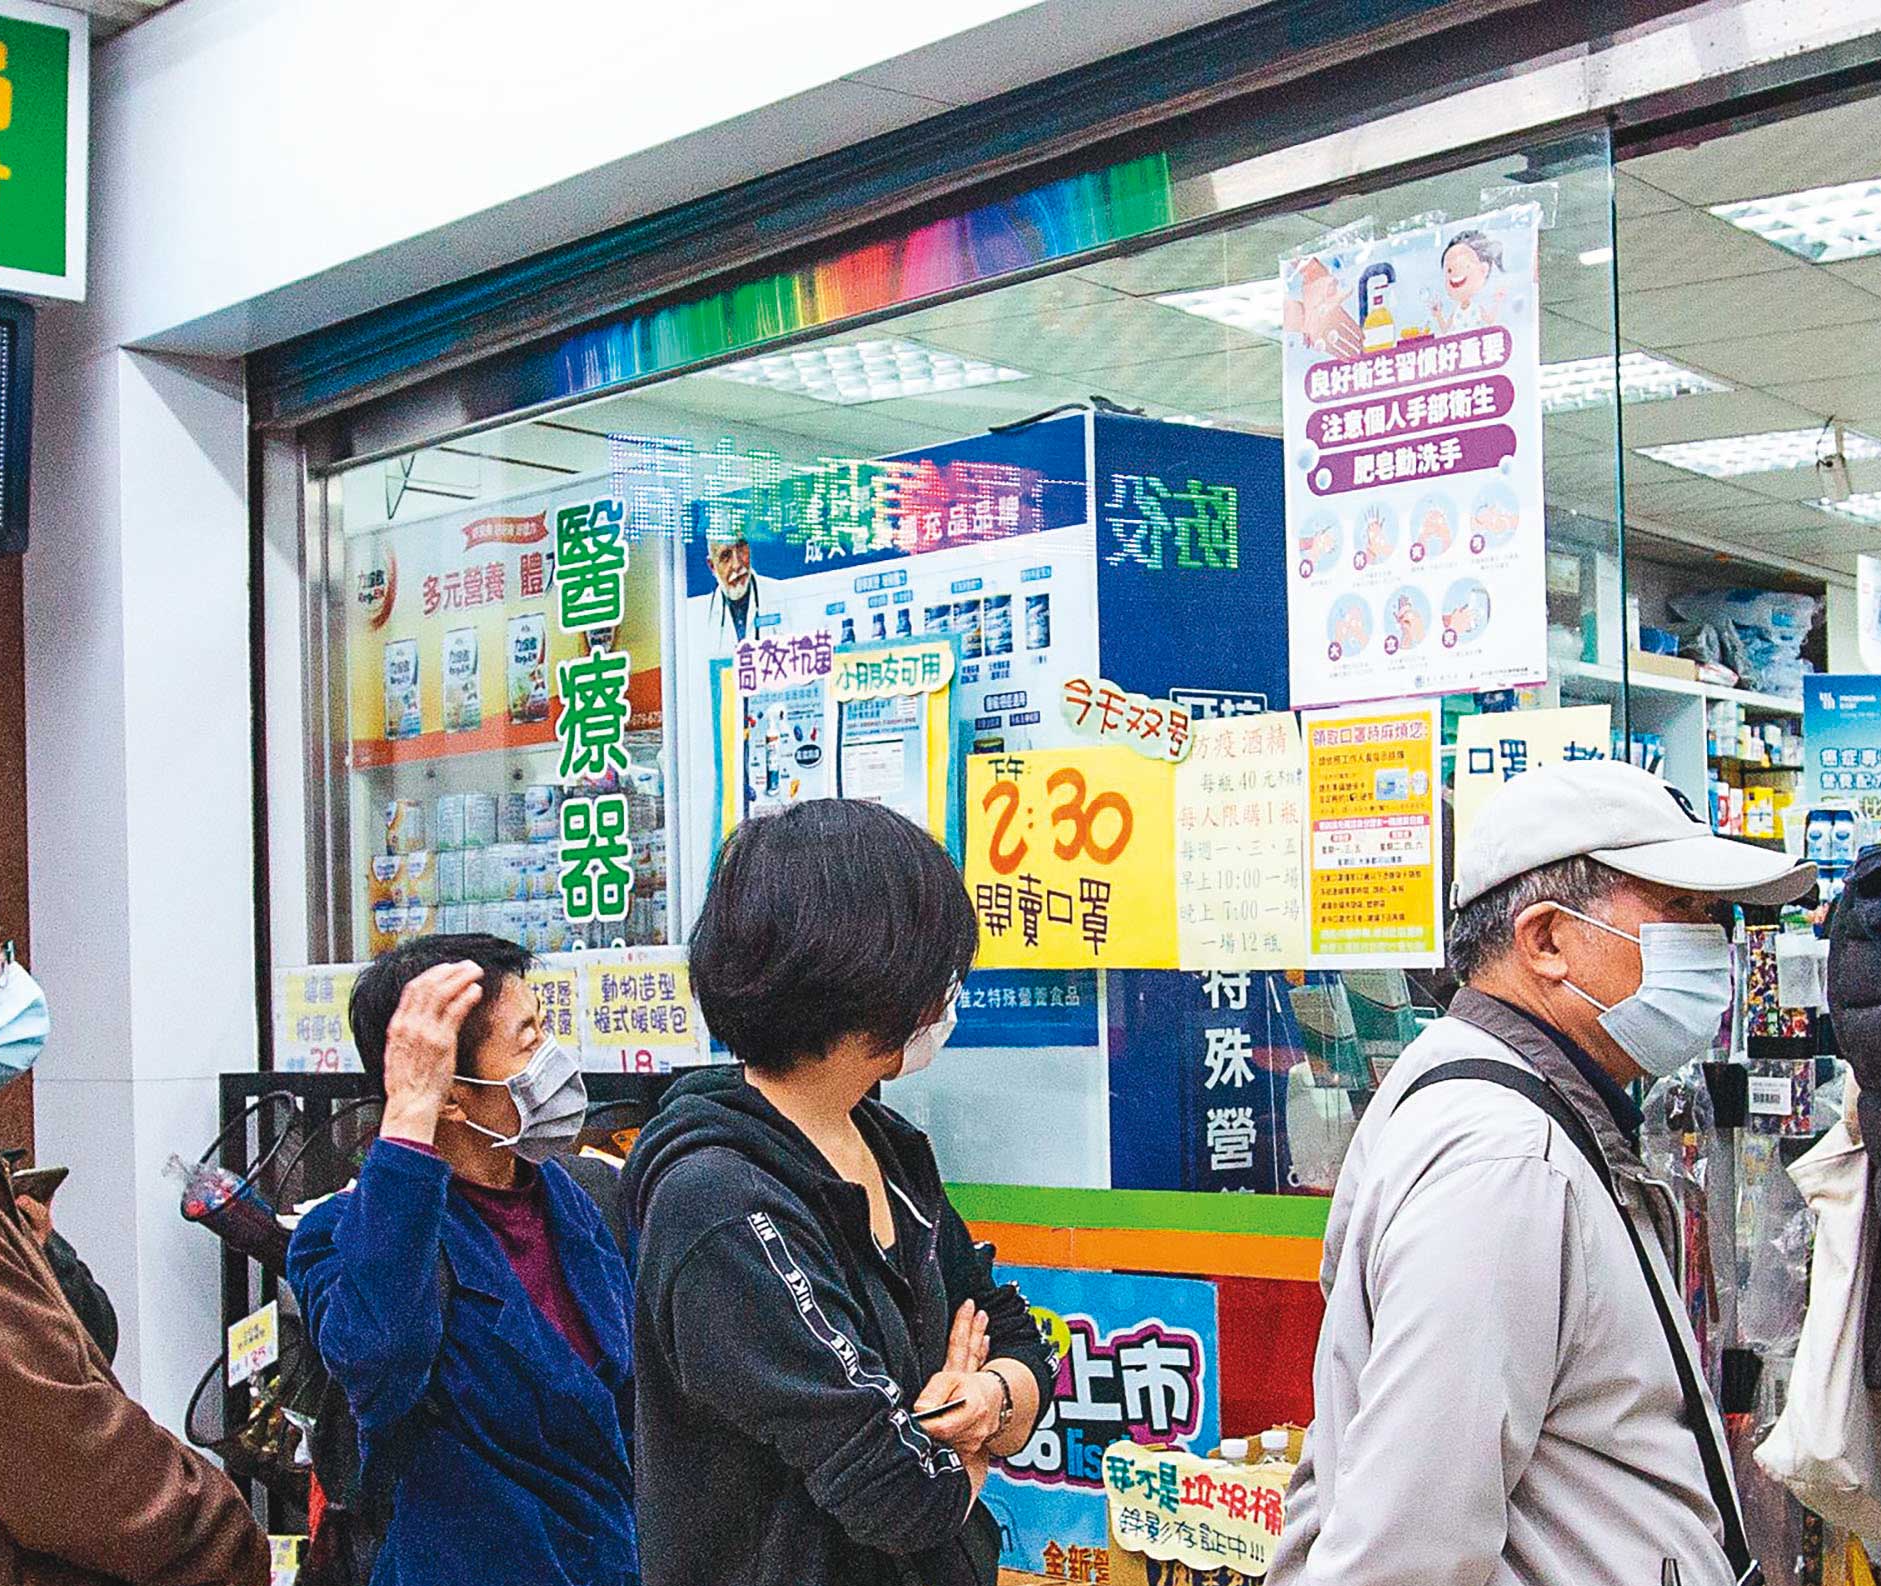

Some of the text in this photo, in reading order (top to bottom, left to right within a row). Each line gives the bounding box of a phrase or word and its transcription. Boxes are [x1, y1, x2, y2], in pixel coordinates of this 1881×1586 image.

[1310, 332, 1505, 398] 良好衛生習慣好重要
[1321, 383, 1496, 443] 注意個人手部衛生
[1353, 438, 1463, 484] 肥皂勤洗手
[423, 562, 505, 615] 多元營養
[736, 631, 833, 691] 高效抗菌
[836, 652, 941, 691] 小朋友可用
[556, 499, 629, 950] 醫療器
[982, 767, 1134, 875] 2:30
[977, 873, 1111, 956] 開賣口罩
[601, 972, 676, 1002] 動物造型
[1203, 969, 1257, 1194] 特殊營
[786, 1269, 815, 1314] NIKE
[831, 1336, 859, 1378] NIKE
[1060, 1333, 1191, 1432] 上市
